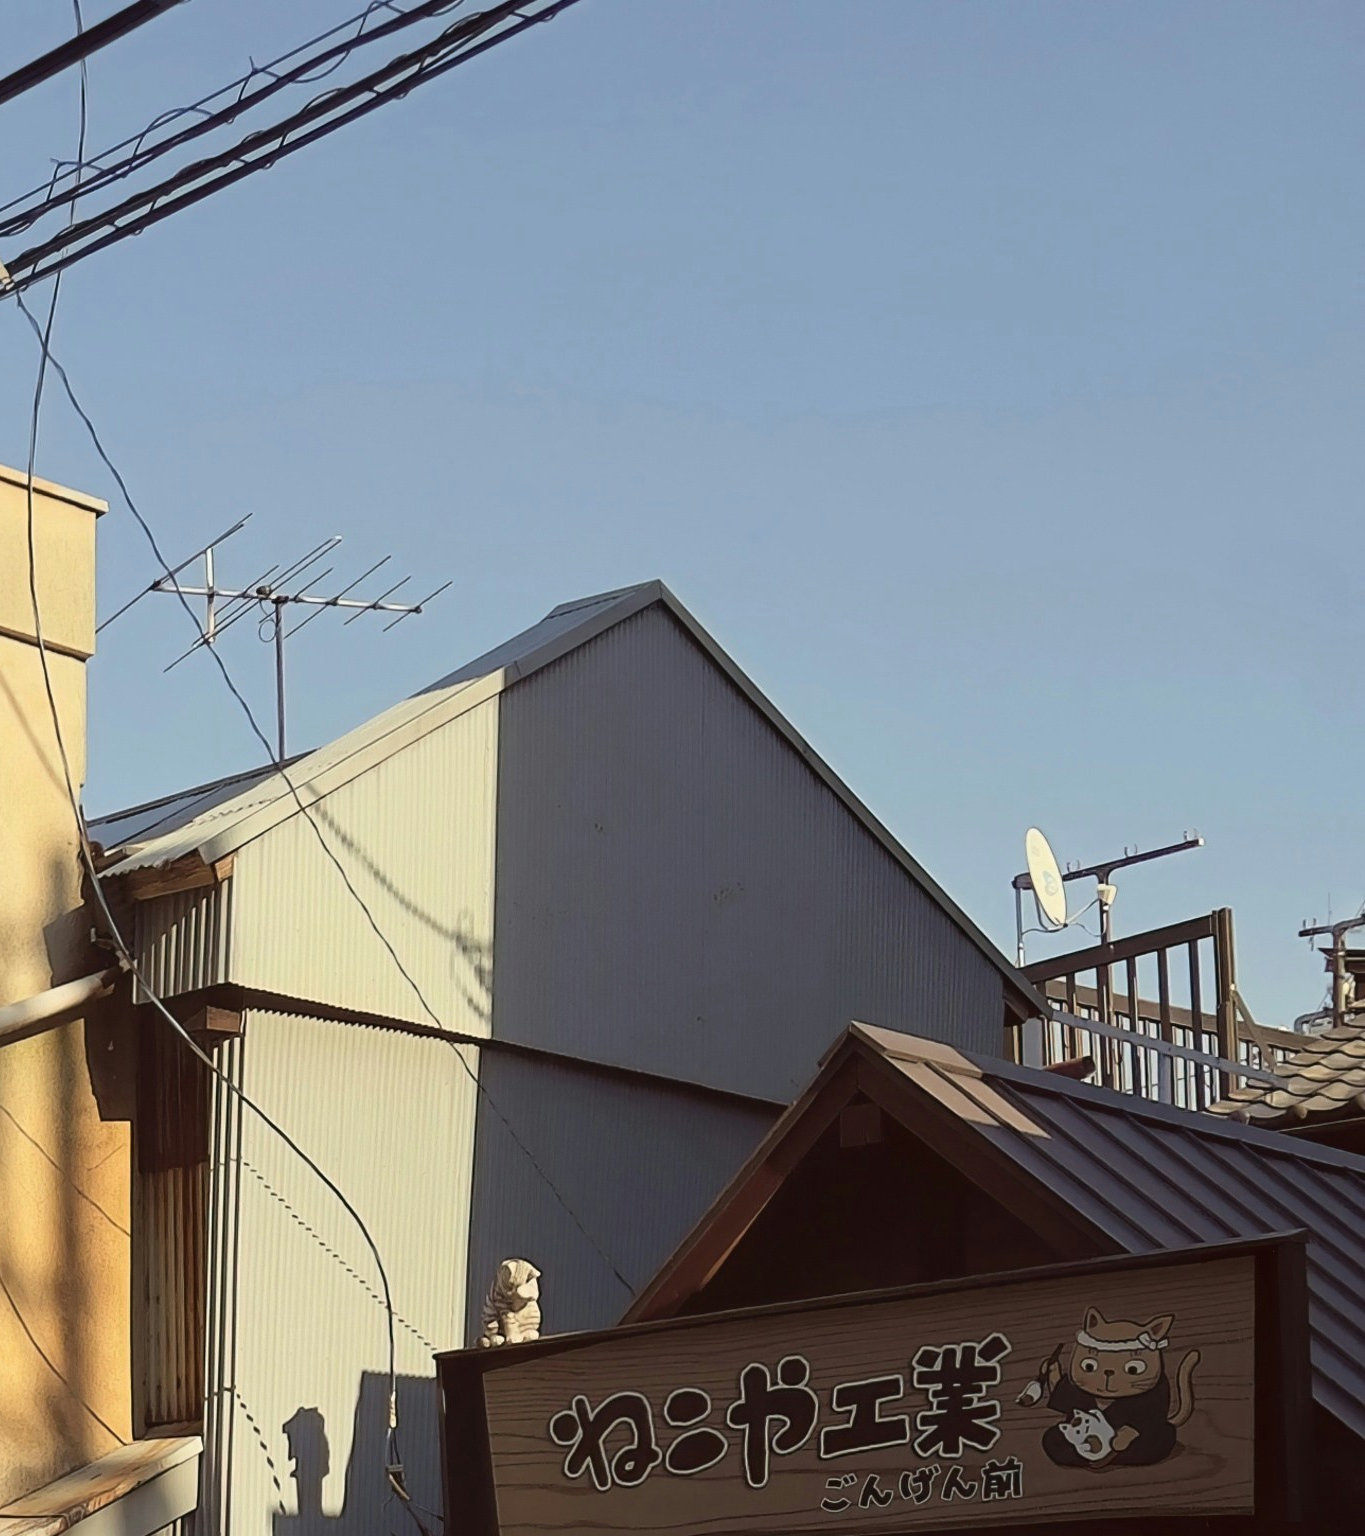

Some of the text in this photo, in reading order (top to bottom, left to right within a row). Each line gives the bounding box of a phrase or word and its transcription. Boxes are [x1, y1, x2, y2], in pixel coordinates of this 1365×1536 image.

[550, 1333, 1011, 1491] ねこや工業
[821, 1456, 1023, 1512] ごんげん前
